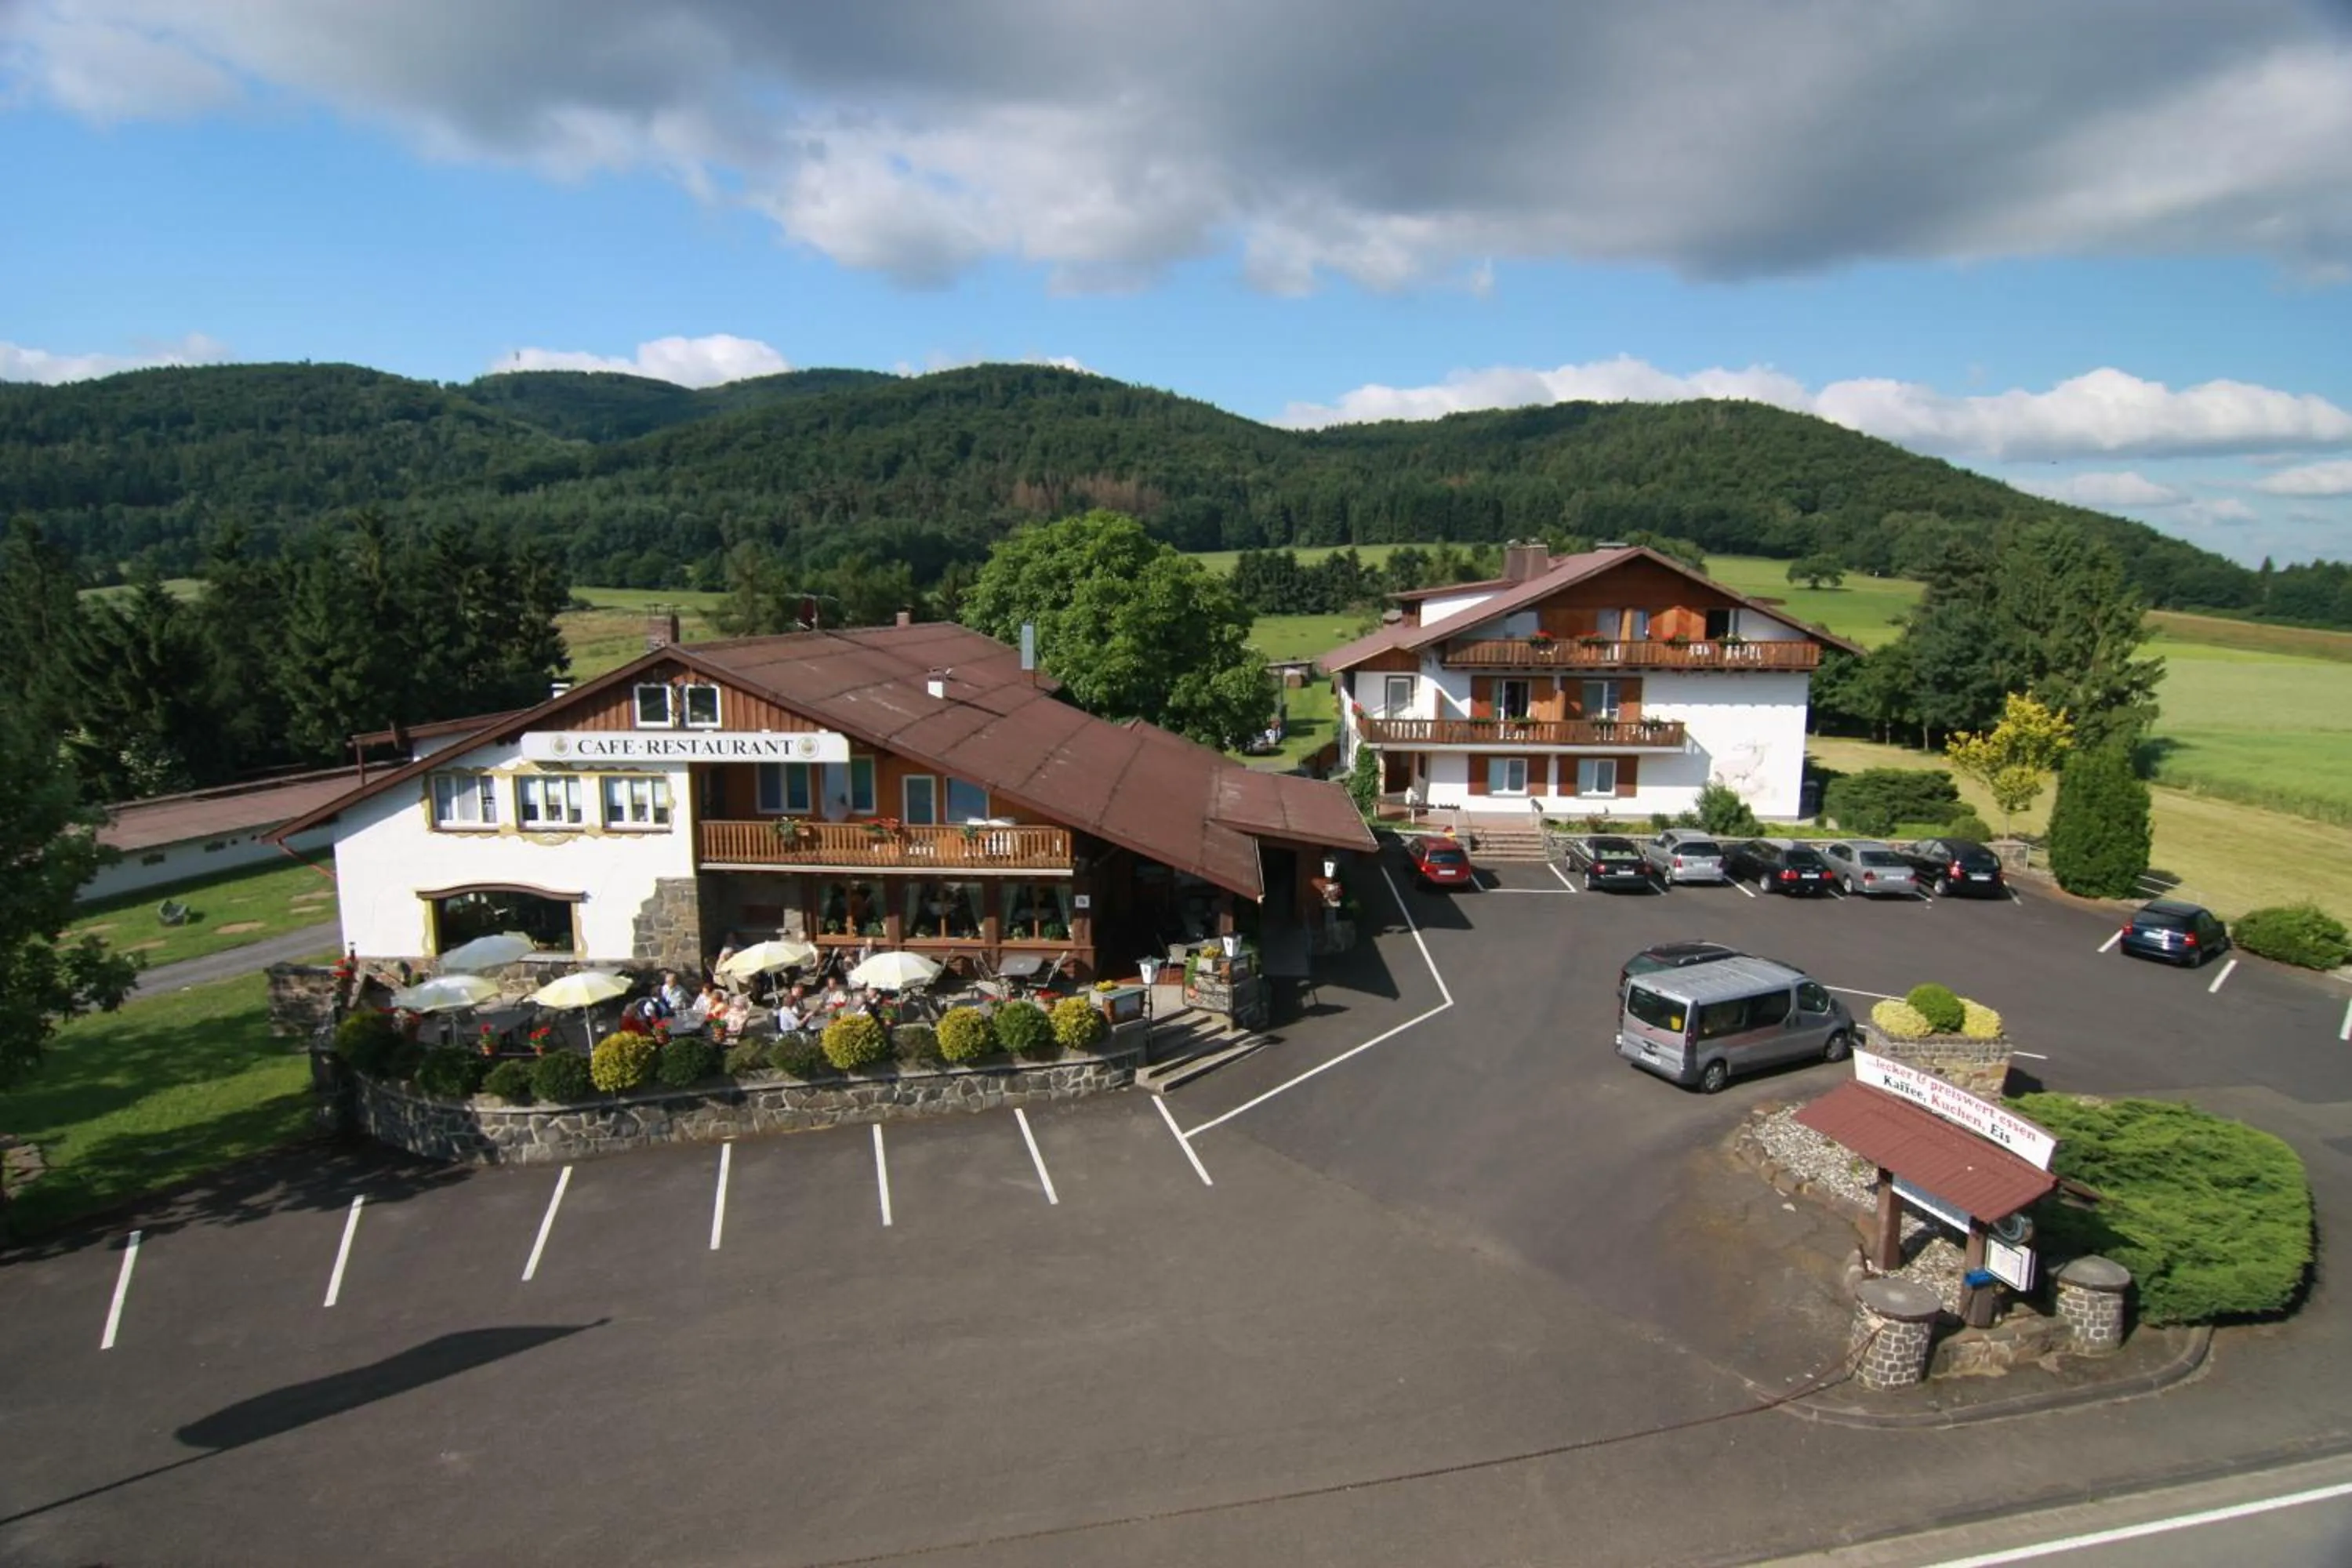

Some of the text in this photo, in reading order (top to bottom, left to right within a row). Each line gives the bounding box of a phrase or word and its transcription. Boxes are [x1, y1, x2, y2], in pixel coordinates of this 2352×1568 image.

[646, 739, 794, 755] RESTAURANT
[1883, 1074, 2012, 1144] Kaffee, Kuchen, Eis
[1929, 1081, 1995, 1119] preiswert
[1998, 1115, 2037, 1142] essen
